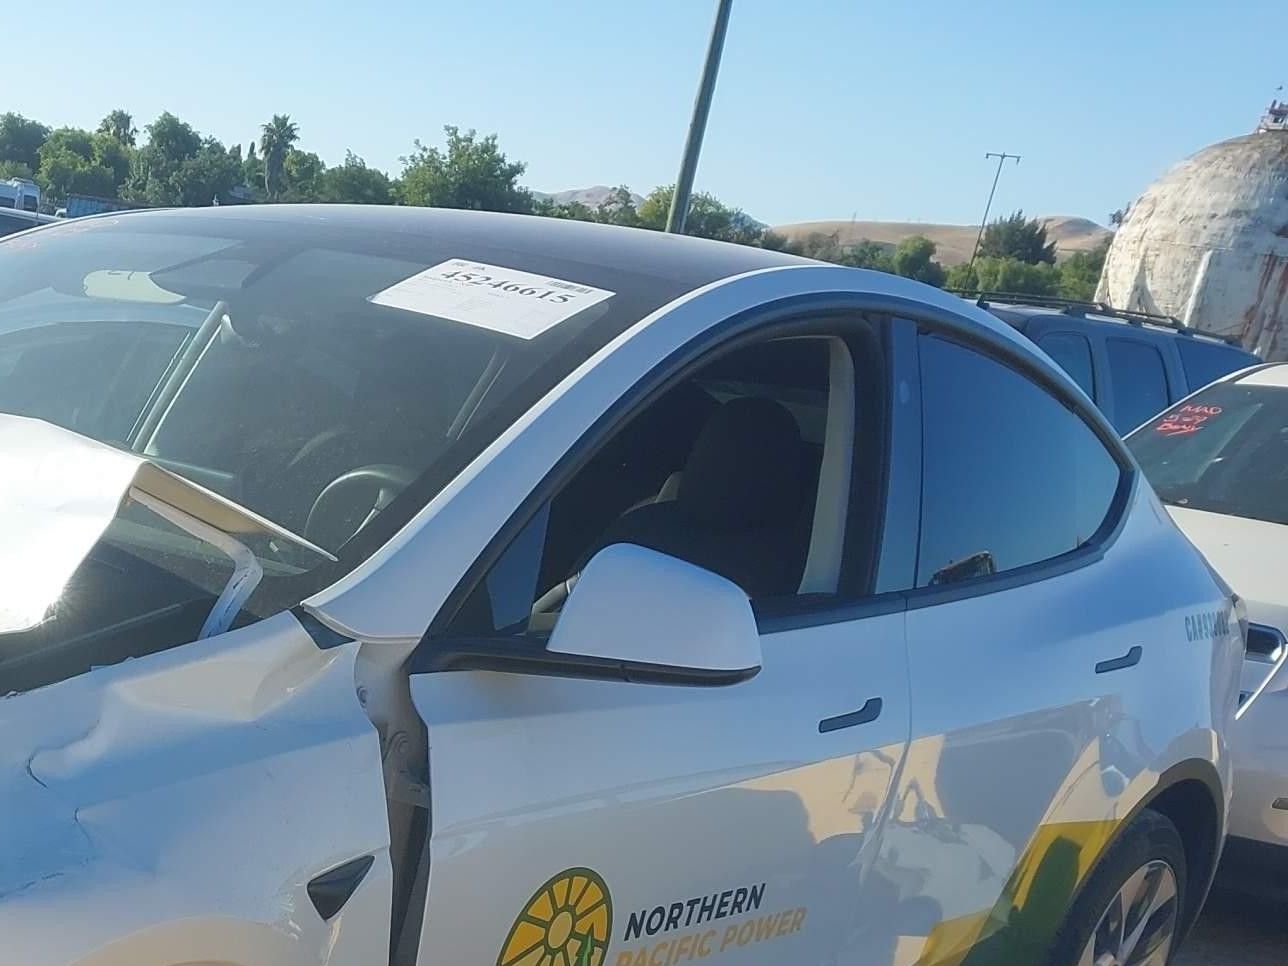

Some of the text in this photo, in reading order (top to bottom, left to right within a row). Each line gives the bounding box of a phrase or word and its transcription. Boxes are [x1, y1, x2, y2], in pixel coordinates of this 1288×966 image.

[441, 270, 576, 303] 45246615
[623, 883, 767, 942] NORTHERN
[720, 906, 808, 953] POWER
